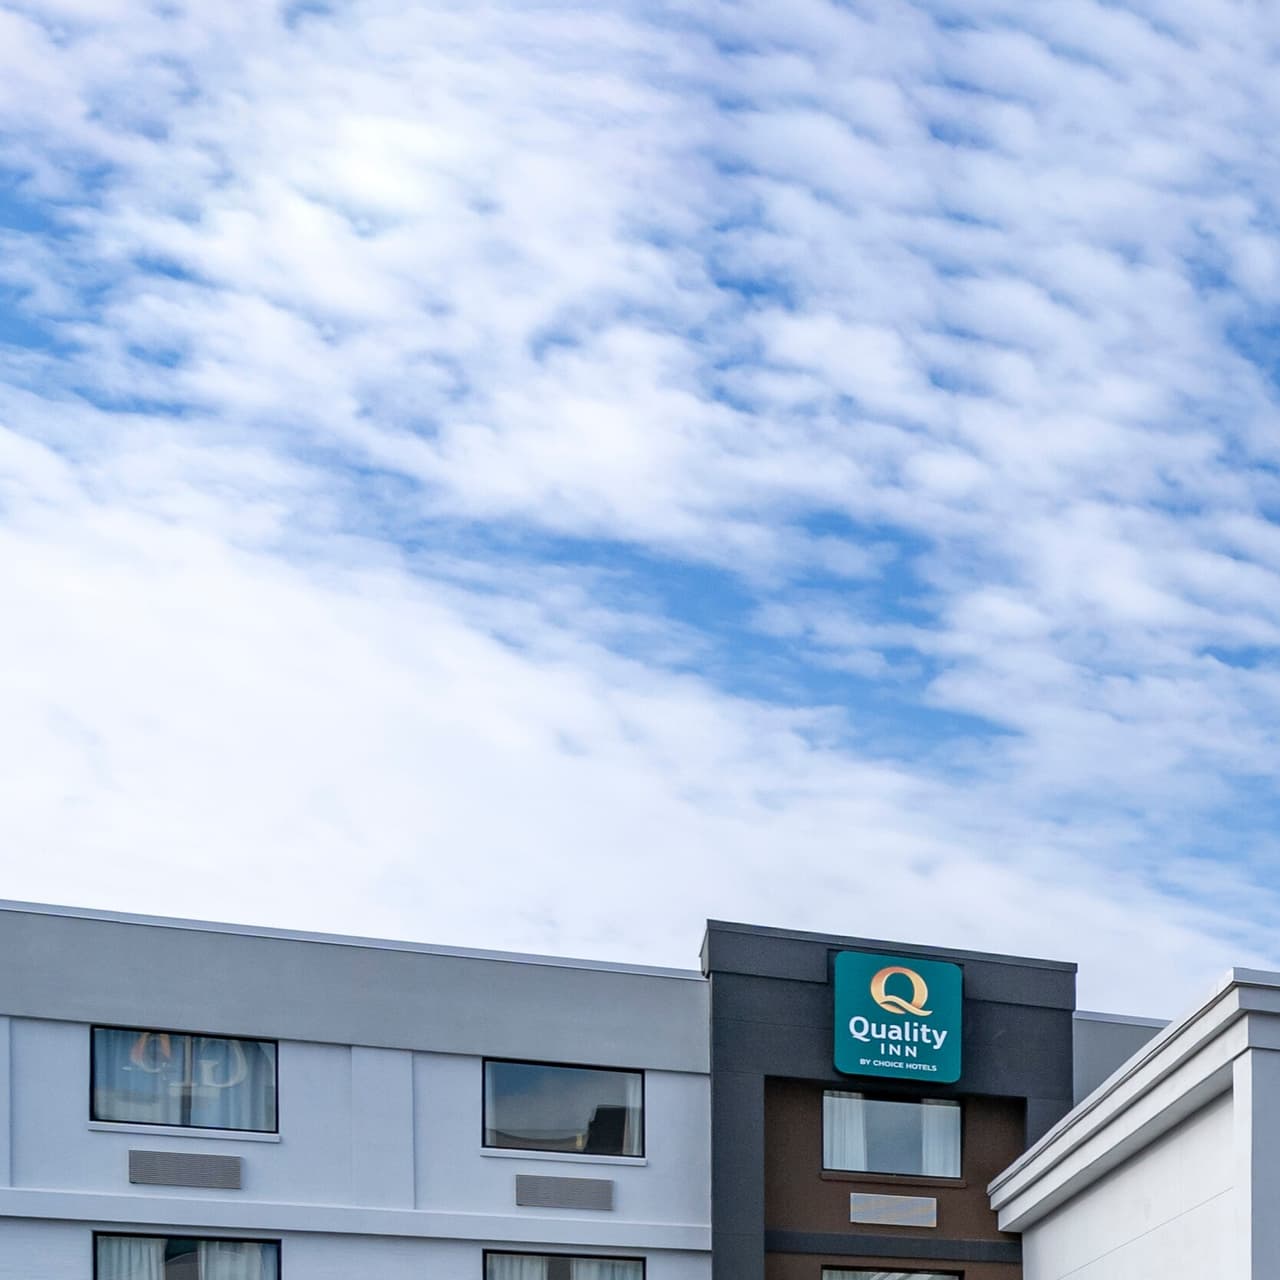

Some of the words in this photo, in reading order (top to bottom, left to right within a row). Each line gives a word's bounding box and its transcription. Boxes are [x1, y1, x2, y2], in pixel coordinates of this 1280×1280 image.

[849, 1016, 948, 1050] Quality
[880, 1043, 917, 1057] INN
[873, 1059, 904, 1068] CHOICE
[906, 1063, 937, 1072] HOTELS
